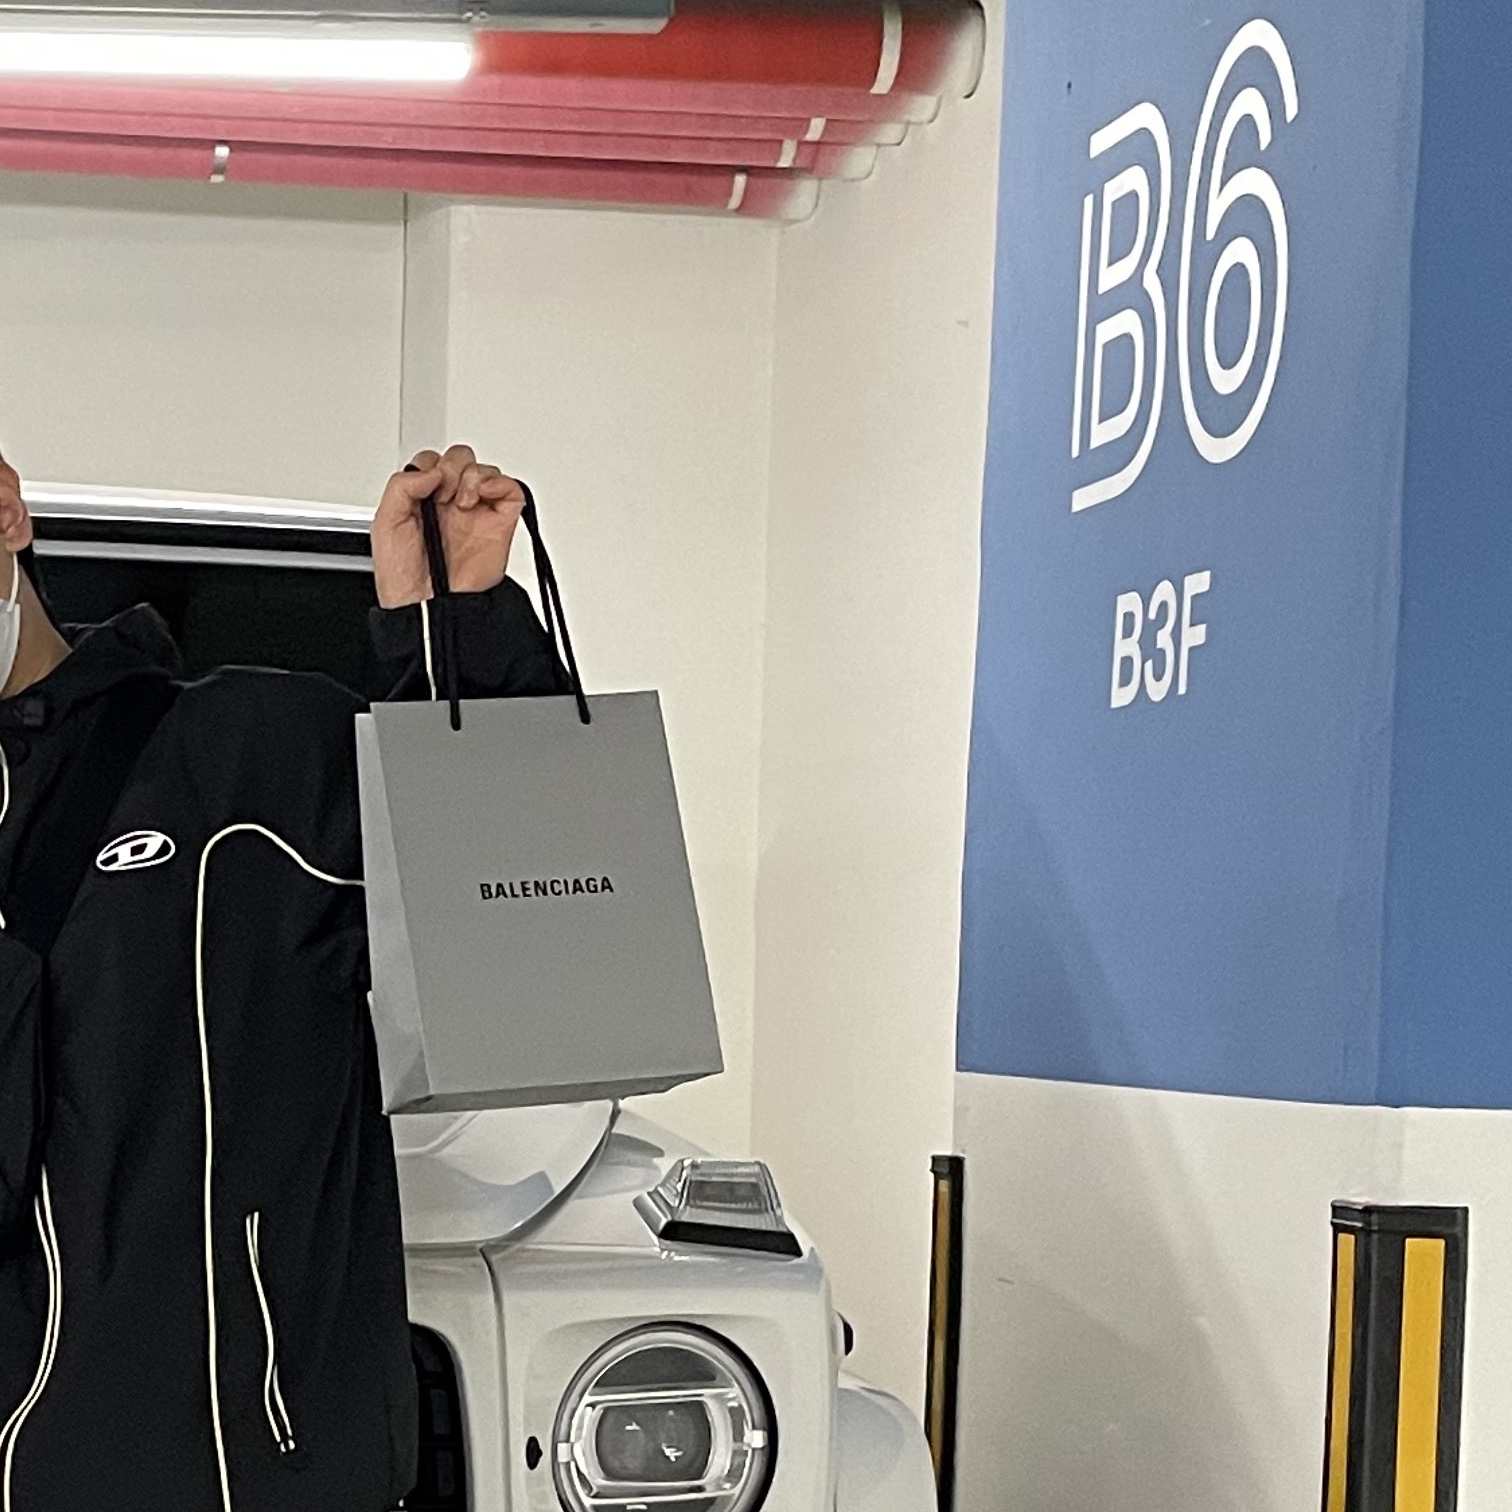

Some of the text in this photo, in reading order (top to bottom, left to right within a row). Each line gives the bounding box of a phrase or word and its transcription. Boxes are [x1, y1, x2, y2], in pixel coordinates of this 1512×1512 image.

[1072, 19, 1299, 513] B6
[1110, 570, 1212, 709] B3F
[479, 876, 615, 901] BALENCIAGA
